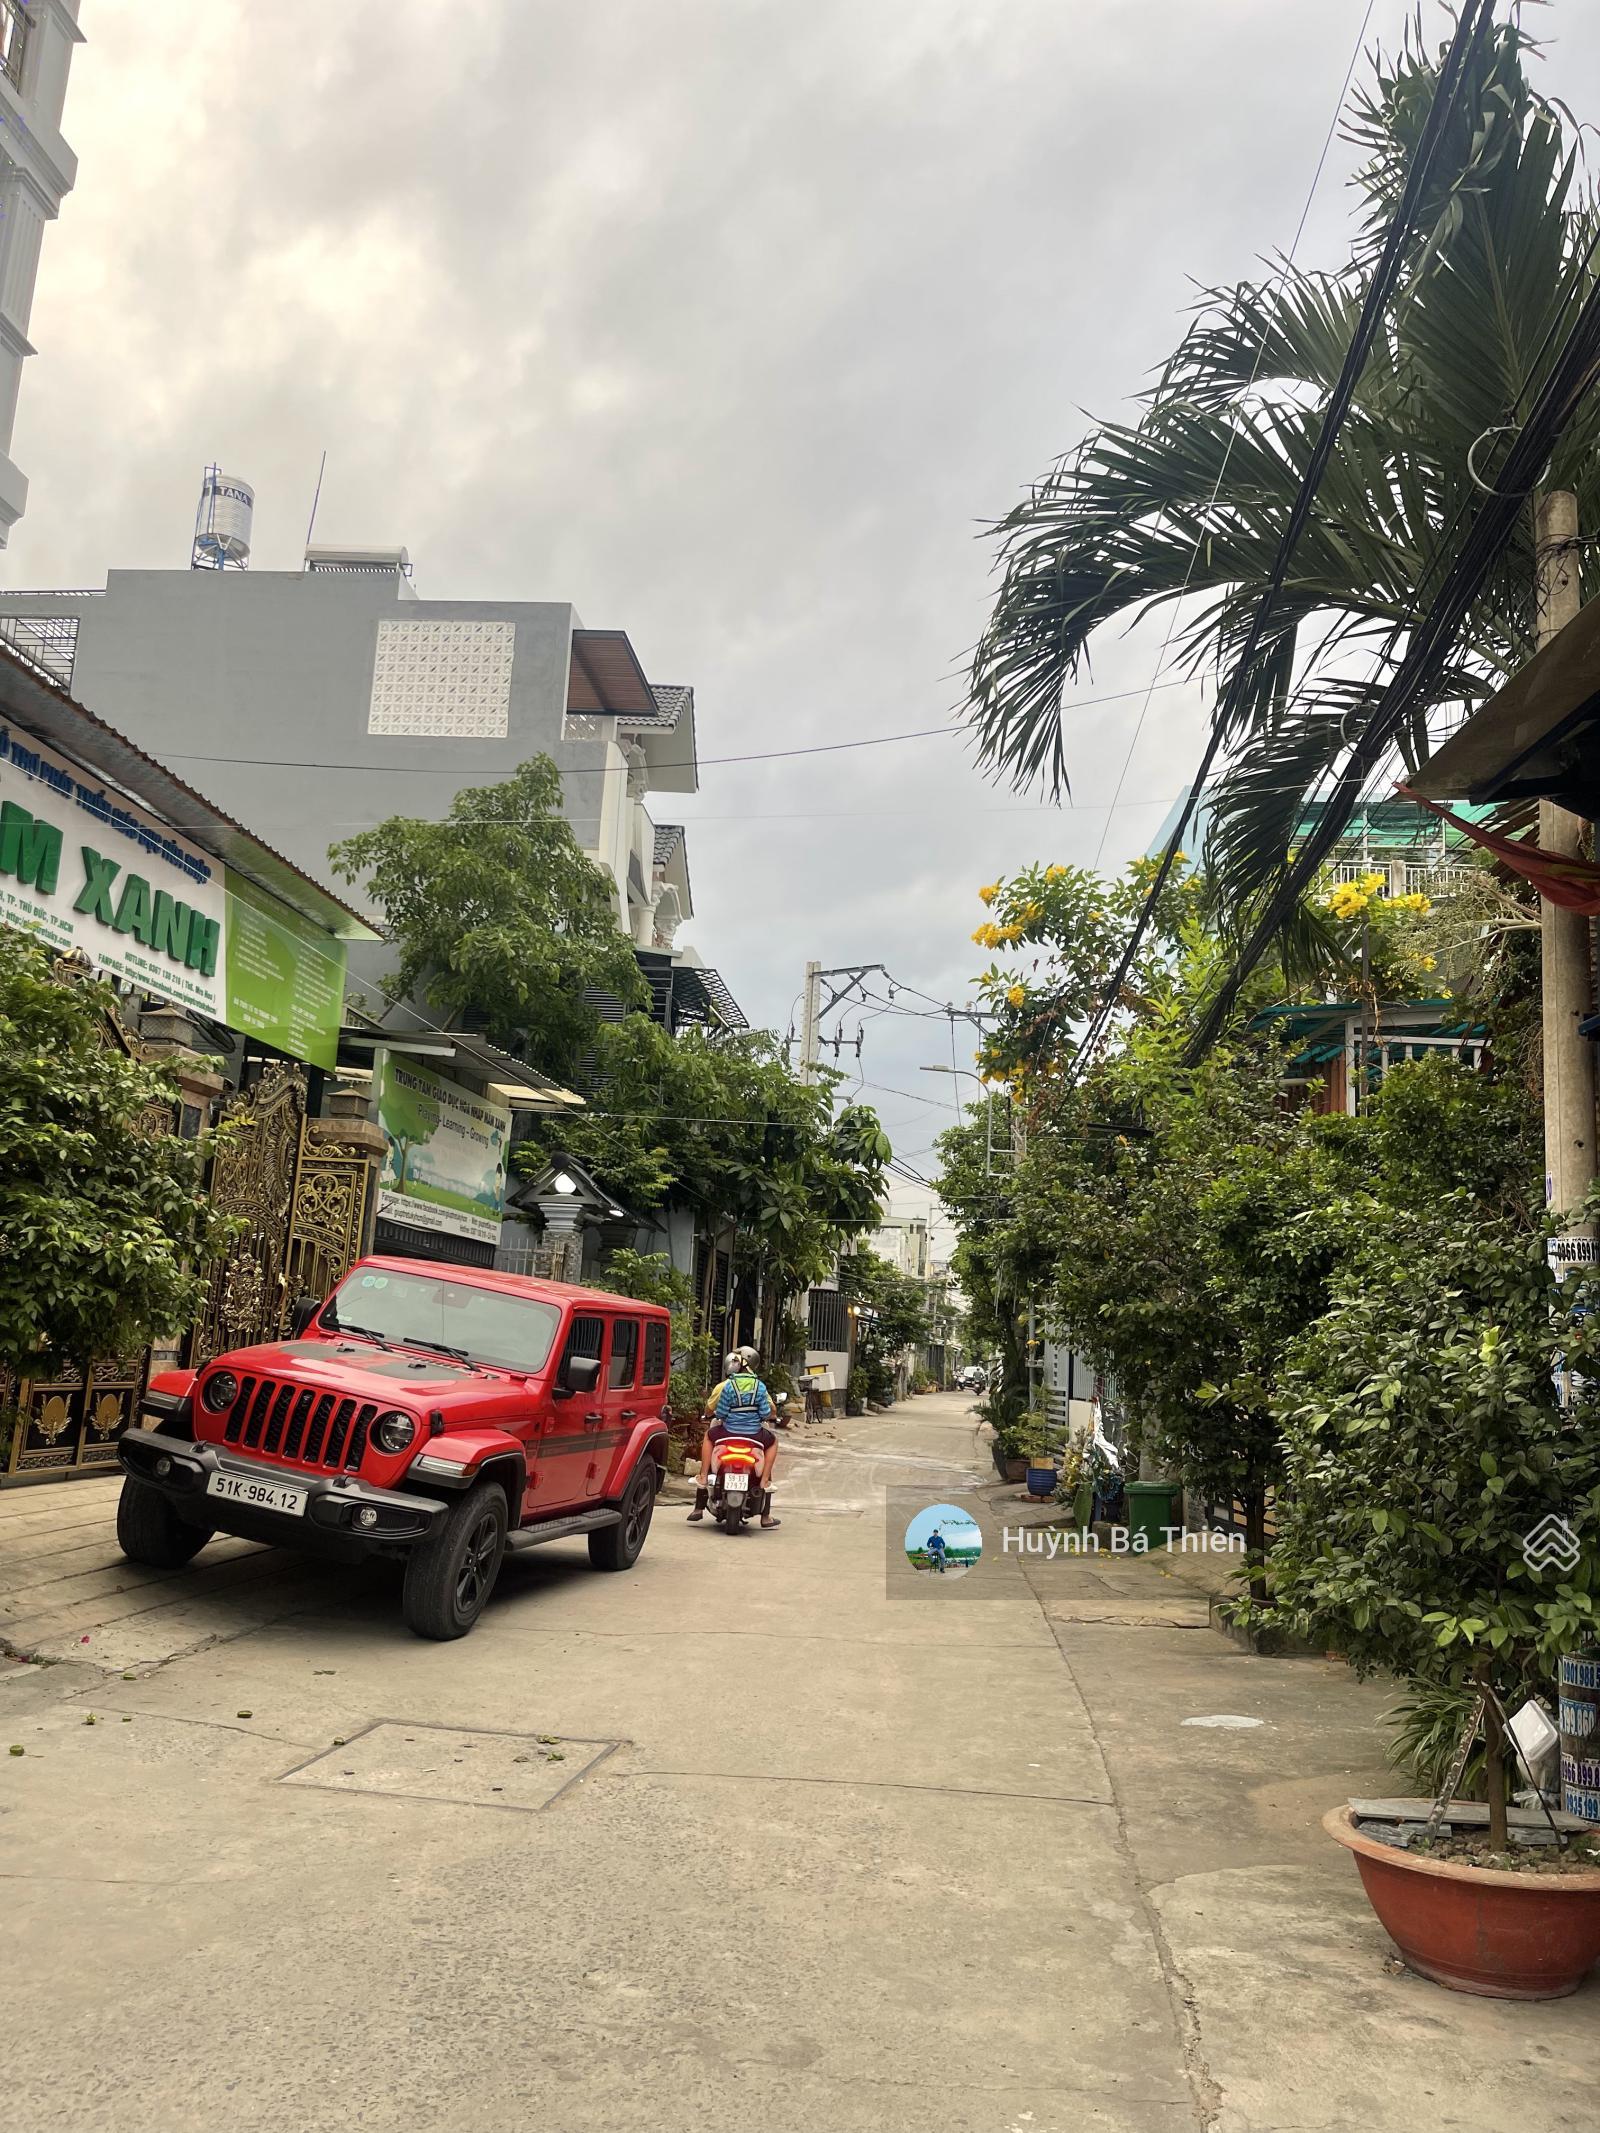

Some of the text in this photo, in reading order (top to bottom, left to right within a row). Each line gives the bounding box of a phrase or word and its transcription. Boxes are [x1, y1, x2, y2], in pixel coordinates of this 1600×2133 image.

[19, 899, 33, 914] THỦ
[73, 846, 221, 979] XANH
[98, 952, 124, 973] FANPAGE:
[125, 951, 148, 970] HOTLINE:
[394, 1066, 418, 1090] TRUNG
[215, 1477, 298, 1510] 51K-984.12
